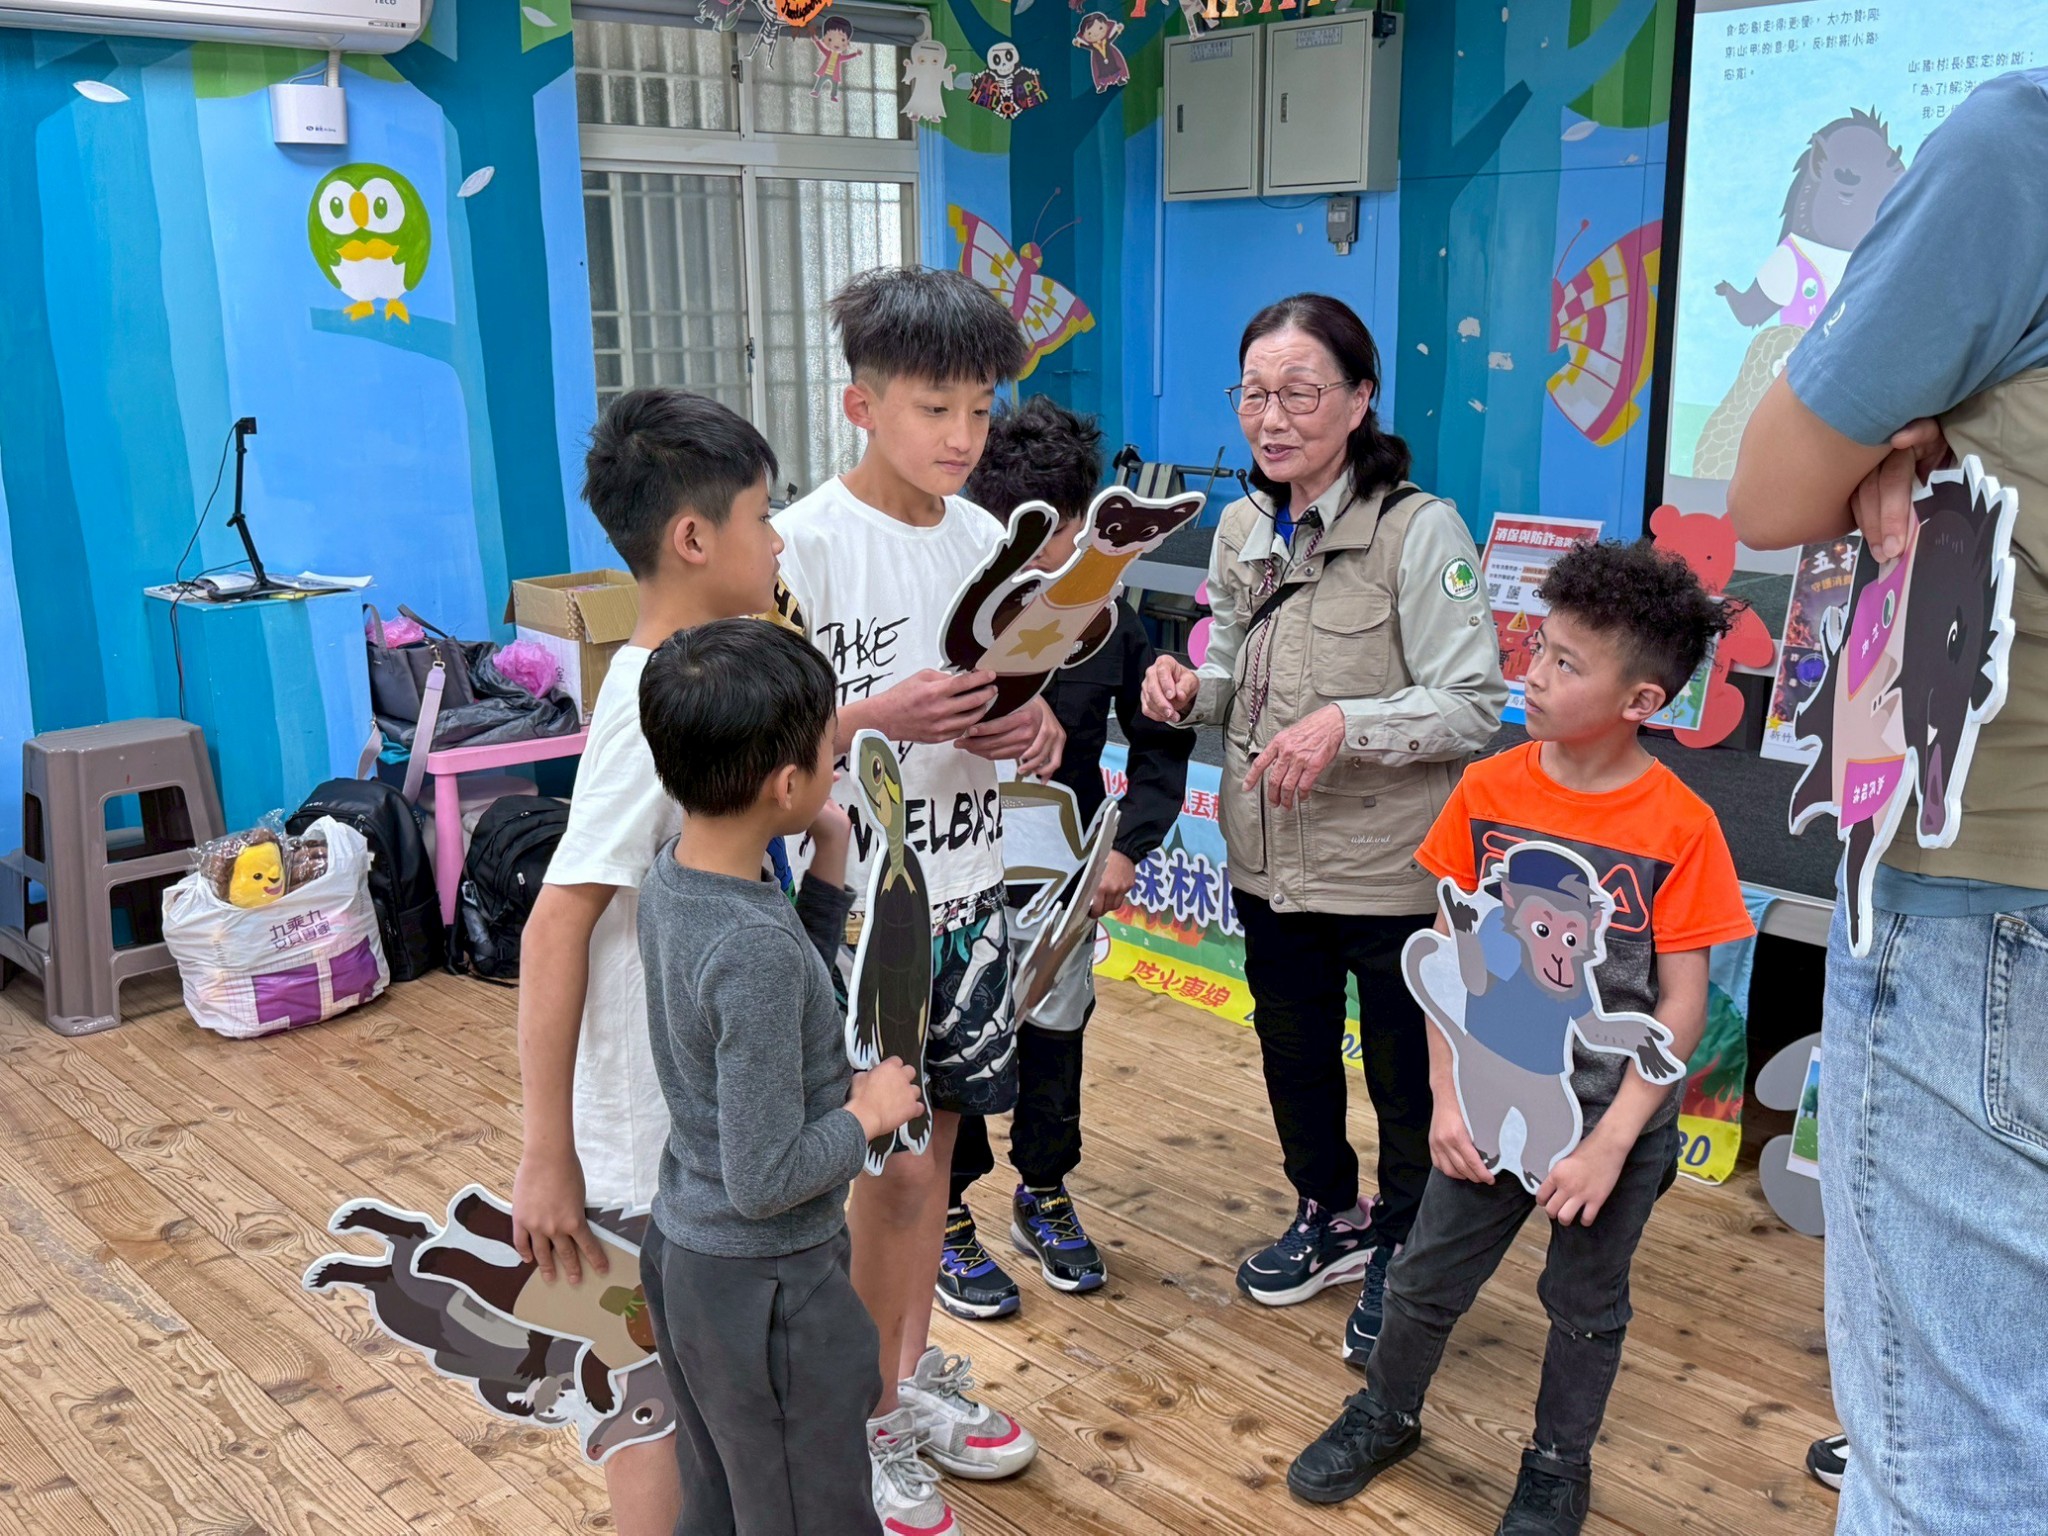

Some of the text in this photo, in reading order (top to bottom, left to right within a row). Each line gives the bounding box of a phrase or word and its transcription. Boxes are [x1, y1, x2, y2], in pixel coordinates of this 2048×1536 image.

[1912, 80, 1978, 96] 「為了解決
[1922, 104, 1959, 119] 我已
[817, 617, 910, 675] TAKE
[269, 909, 327, 942] 九乘九
[1131, 959, 1231, 1008] 防火專線
